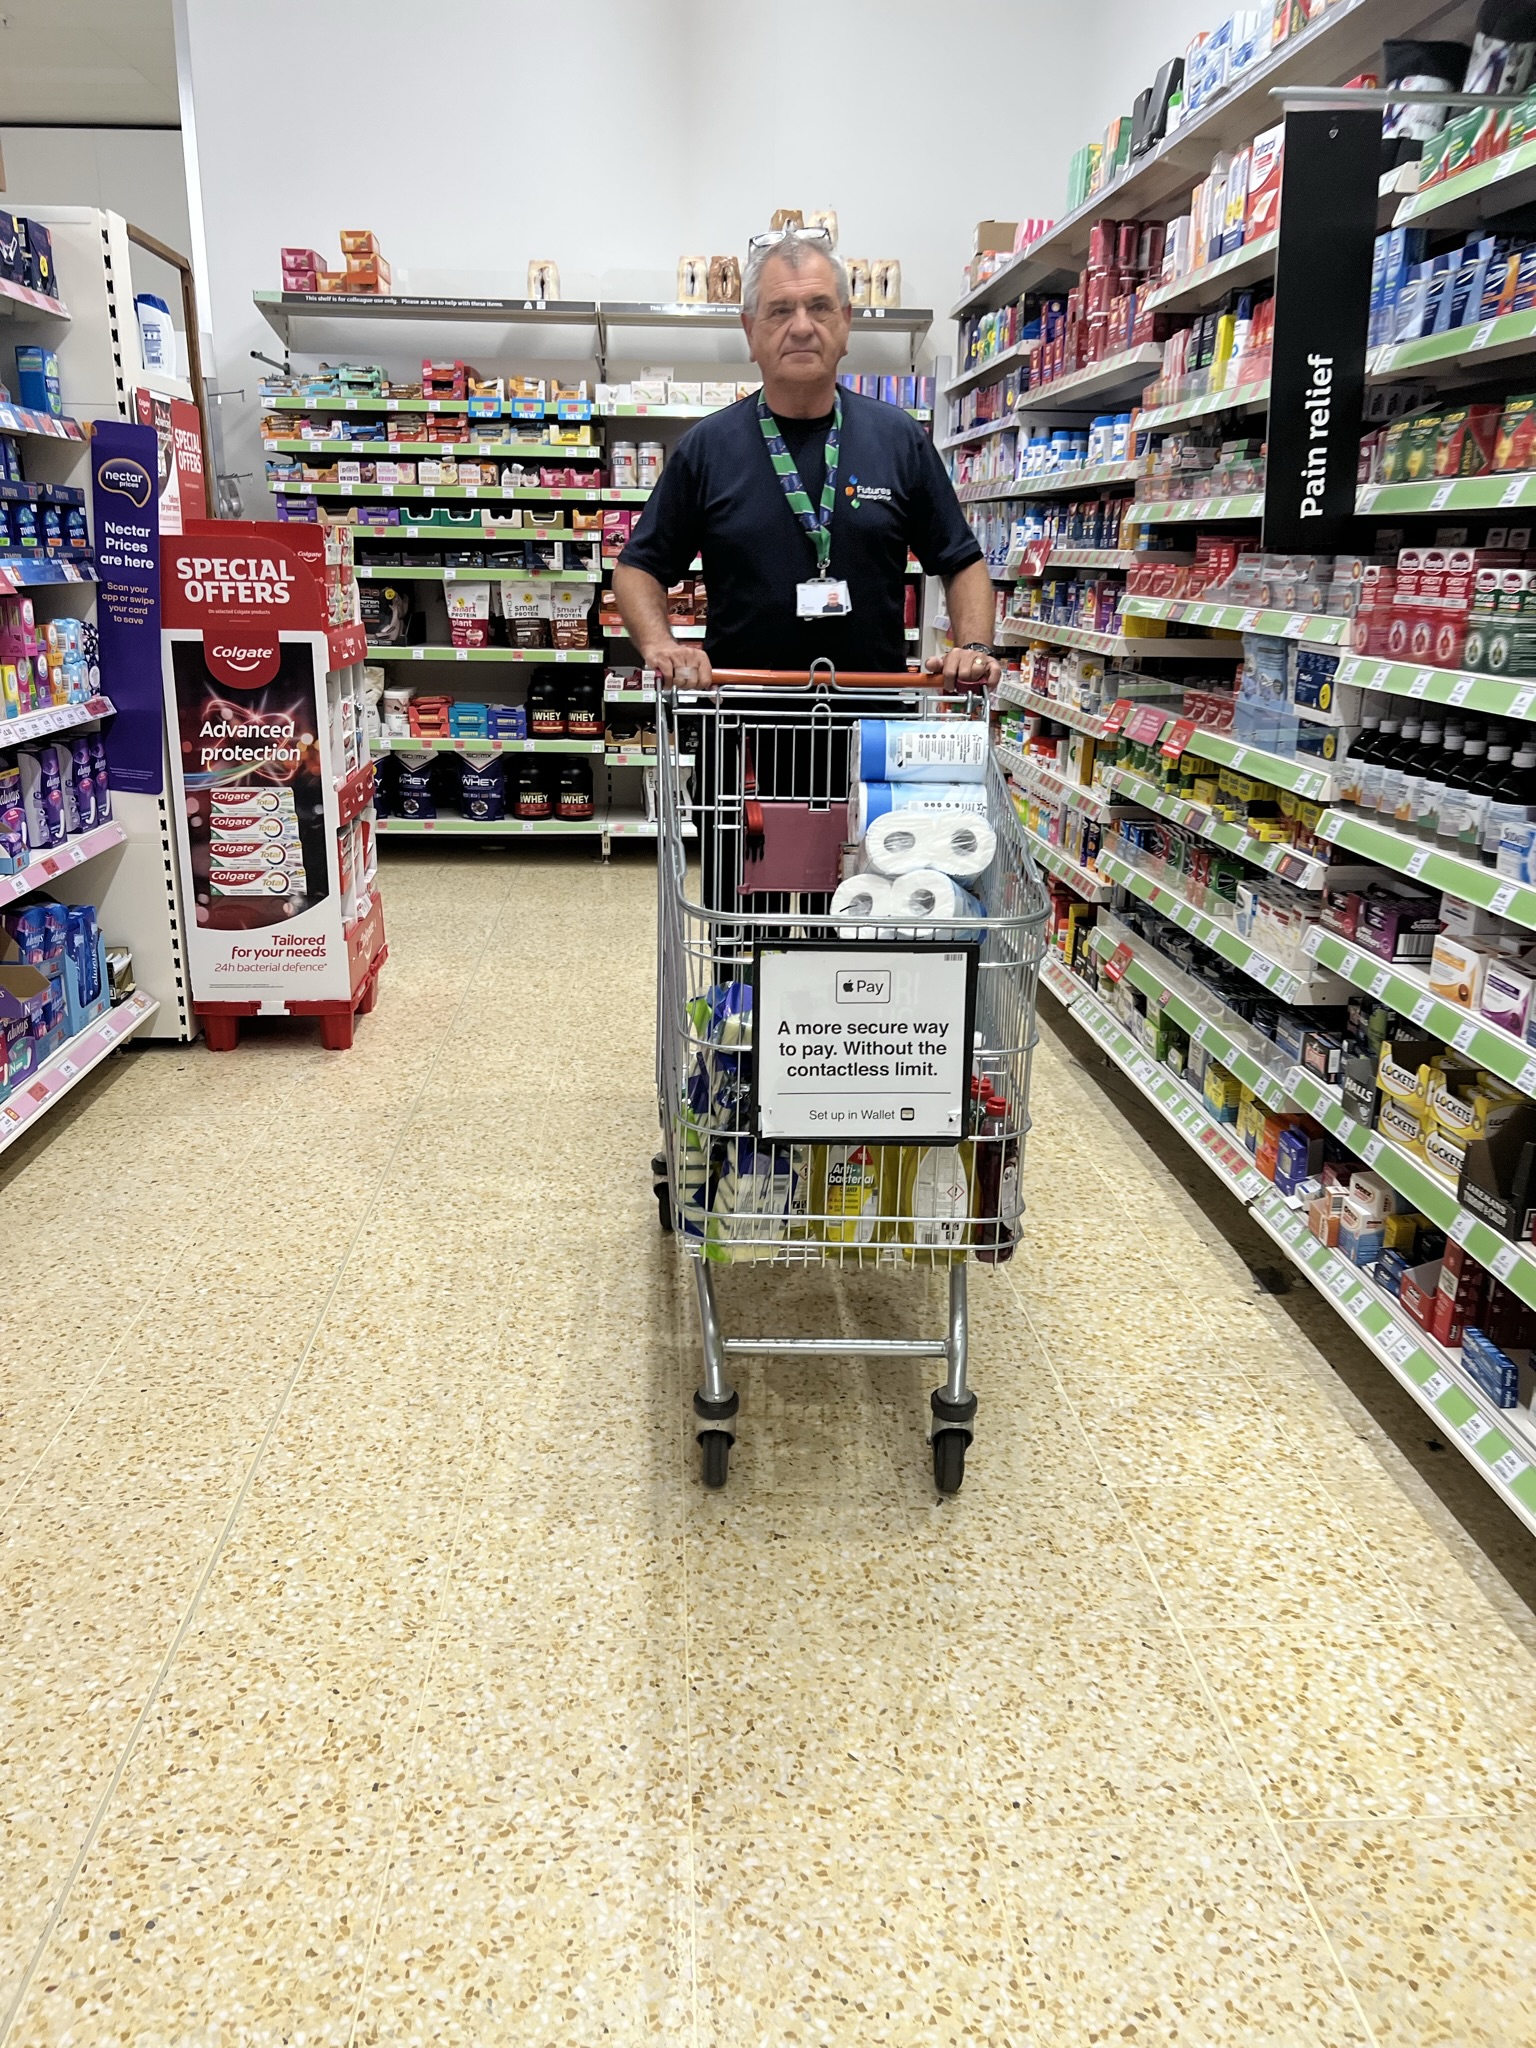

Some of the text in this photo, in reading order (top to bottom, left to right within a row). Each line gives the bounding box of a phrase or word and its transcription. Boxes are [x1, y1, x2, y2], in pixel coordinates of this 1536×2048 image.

[347, 296, 372, 304] colleague
[175, 428, 202, 454] SPECIAL
[1300, 354, 1333, 518] Pain relief
[178, 450, 202, 474] OFFERS
[105, 471, 143, 483] nectar
[119, 481, 139, 489] prices
[857, 486, 891, 495] Futures
[104, 522, 151, 538] Nectar
[106, 538, 148, 553] Prices
[297, 551, 322, 559] Colgate
[100, 555, 154, 569] are here
[176, 557, 295, 582] SPECIAL
[107, 582, 148, 594] Scan your
[184, 581, 291, 604] OFFERS
[101, 593, 117, 603] app
[129, 595, 155, 605] swipe
[109, 605, 148, 615] your card
[452, 619, 472, 627] plant
[557, 620, 578, 628] plant
[212, 646, 273, 661] Colgate
[536, 712, 561, 720] WHEY
[570, 713, 595, 721] WHEY
[200, 720, 295, 739] Advanced
[201, 743, 301, 766] protection
[212, 792, 250, 802] Colgate
[523, 795, 548, 803] WHEY
[212, 818, 252, 828] Colgate
[211, 844, 254, 854] Colgate
[211, 872, 256, 881] Colgate
[271, 934, 325, 946] Tailored
[232, 946, 326, 960] for your needs
[214, 963, 234, 972] 24h
[236, 963, 278, 972] bacterial
[857, 980, 884, 995] Pay
[778, 1022, 949, 1037] A more secure way
[779, 1041, 947, 1059] to pay. Without the
[787, 1062, 938, 1077] contactless limit.
[1382, 1062, 1416, 1091] LOCKETS
[1345, 1077, 1373, 1102] HALLS
[1435, 1090, 1471, 1122] LOCKETS
[809, 1110, 895, 1121] Set up in Wallet
[1383, 1108, 1416, 1137] LOCKETS
[828, 1174, 876, 1186] bacteral
